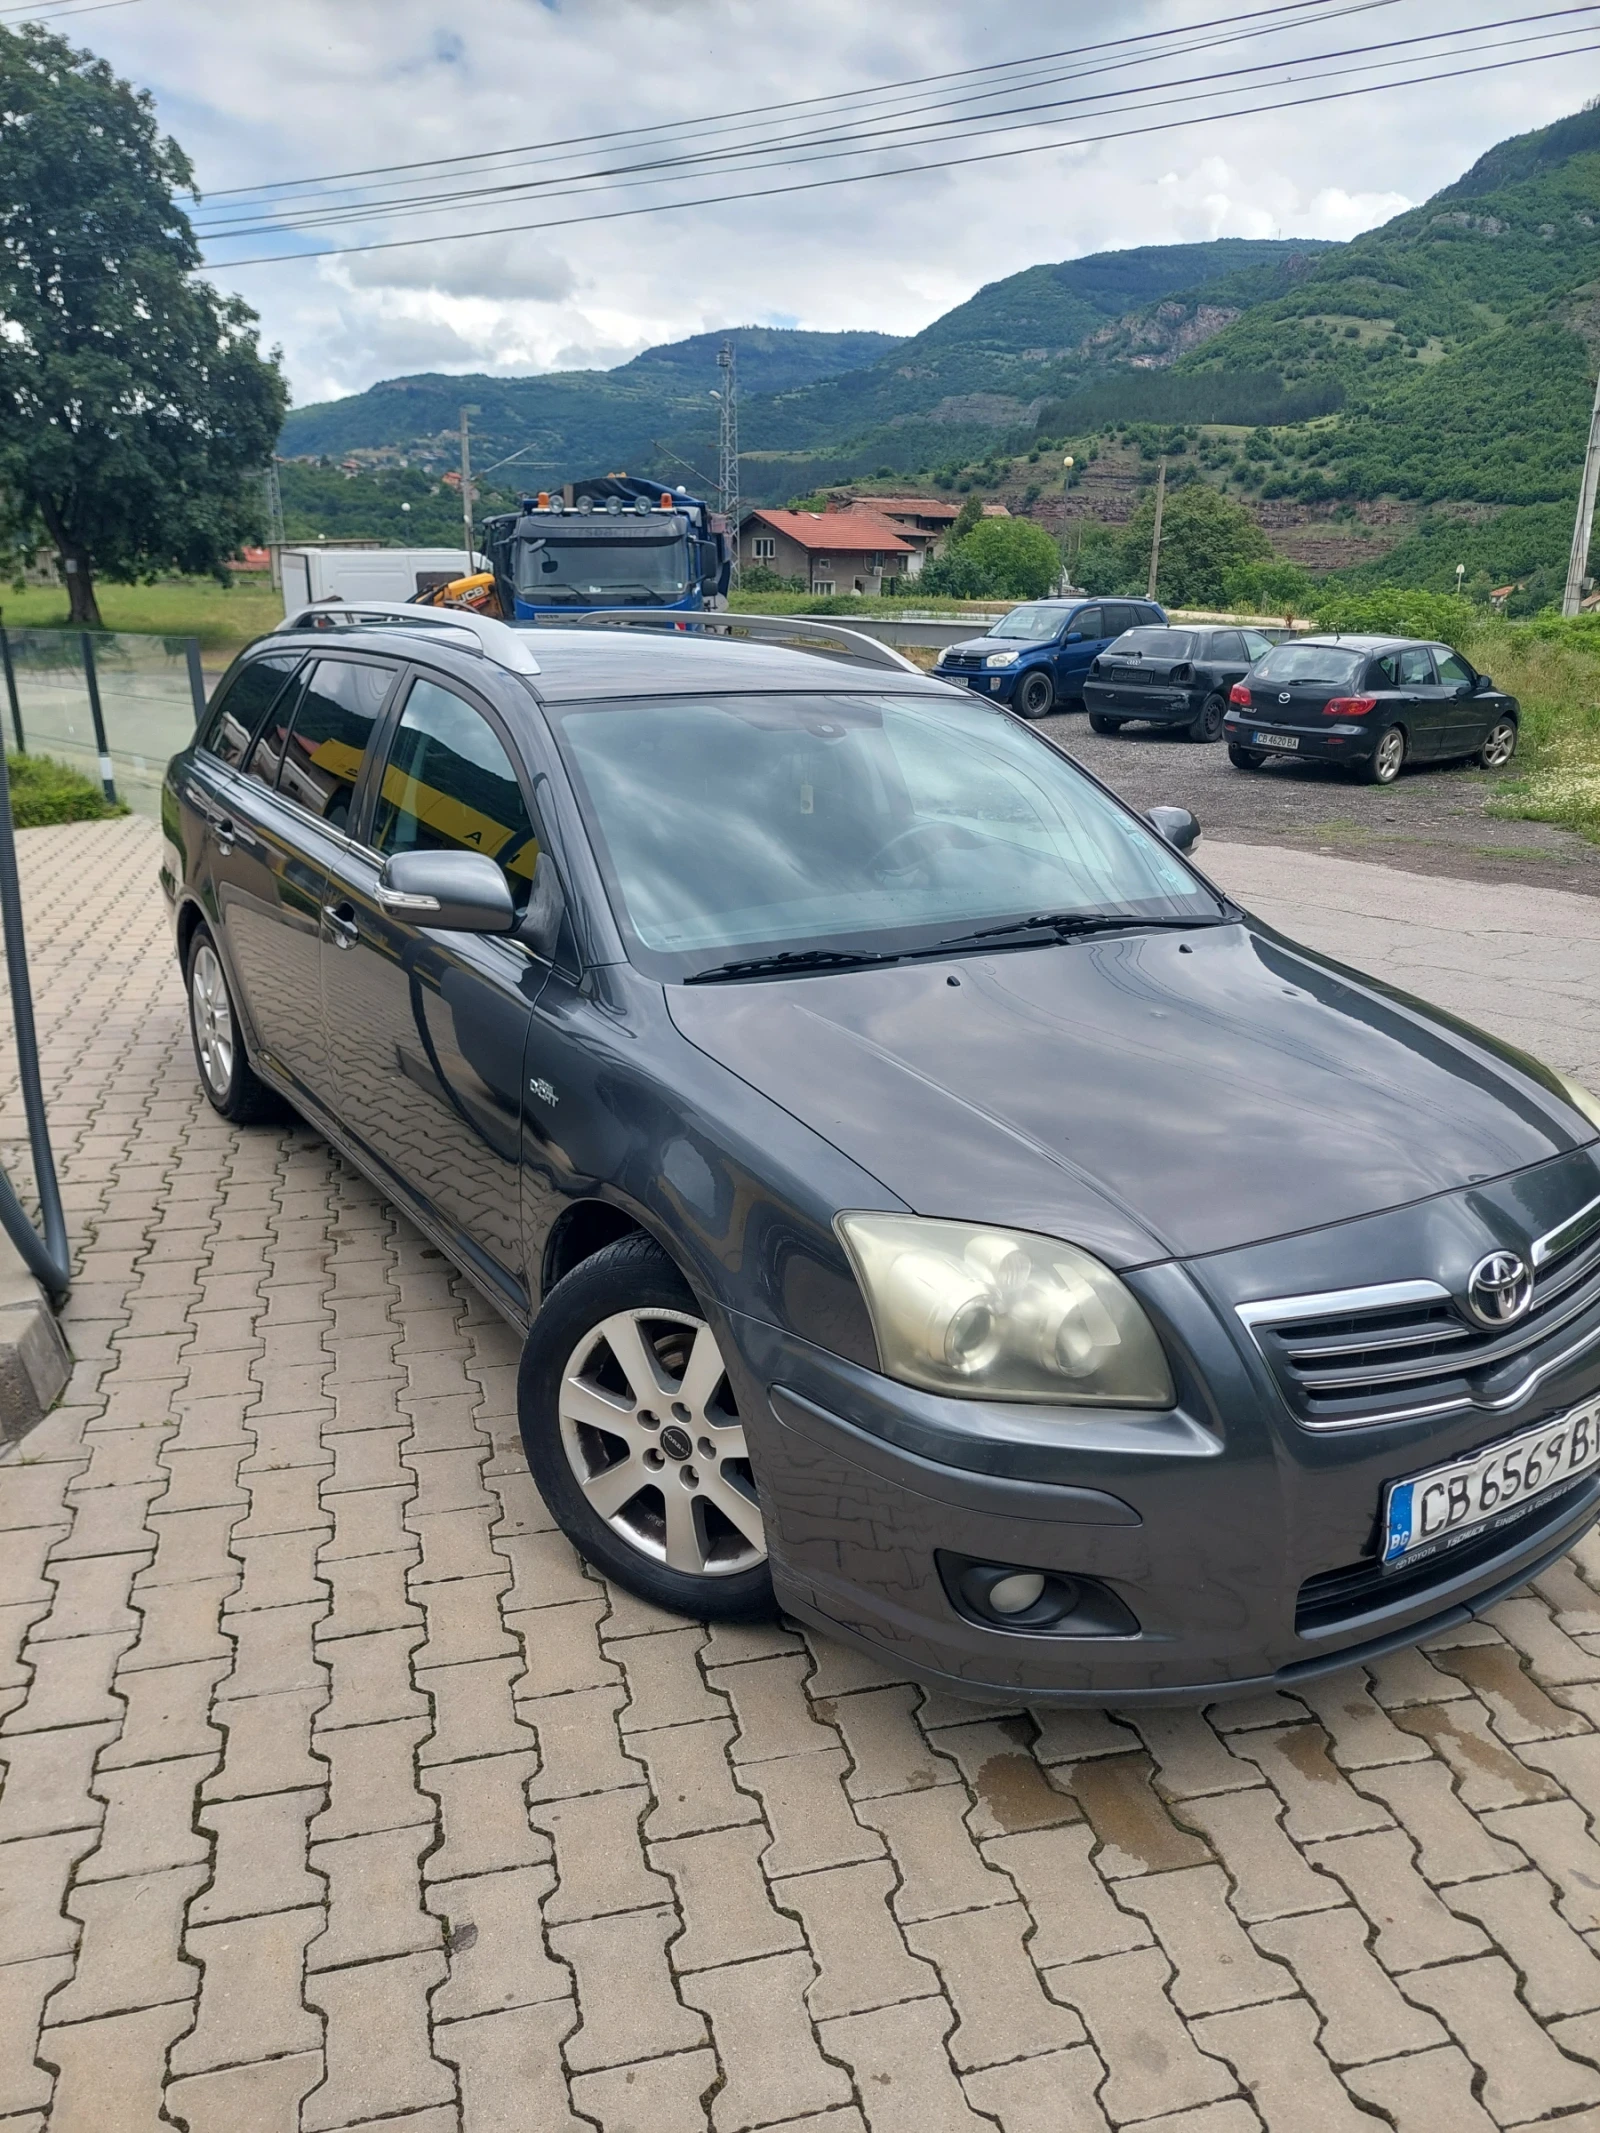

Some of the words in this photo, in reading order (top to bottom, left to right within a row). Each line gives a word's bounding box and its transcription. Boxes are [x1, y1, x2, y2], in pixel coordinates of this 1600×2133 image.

[460, 586, 485, 603] JCB
[1257, 733, 1268, 744] CB
[1268, 735, 1287, 747] 4620
[1287, 738, 1297, 748] BA
[1420, 1474, 1471, 1538] CB
[1479, 1431, 1567, 1512] 6569
[1390, 1531, 1409, 1550] BG
[1407, 1546, 1437, 1565] TOYOTA
